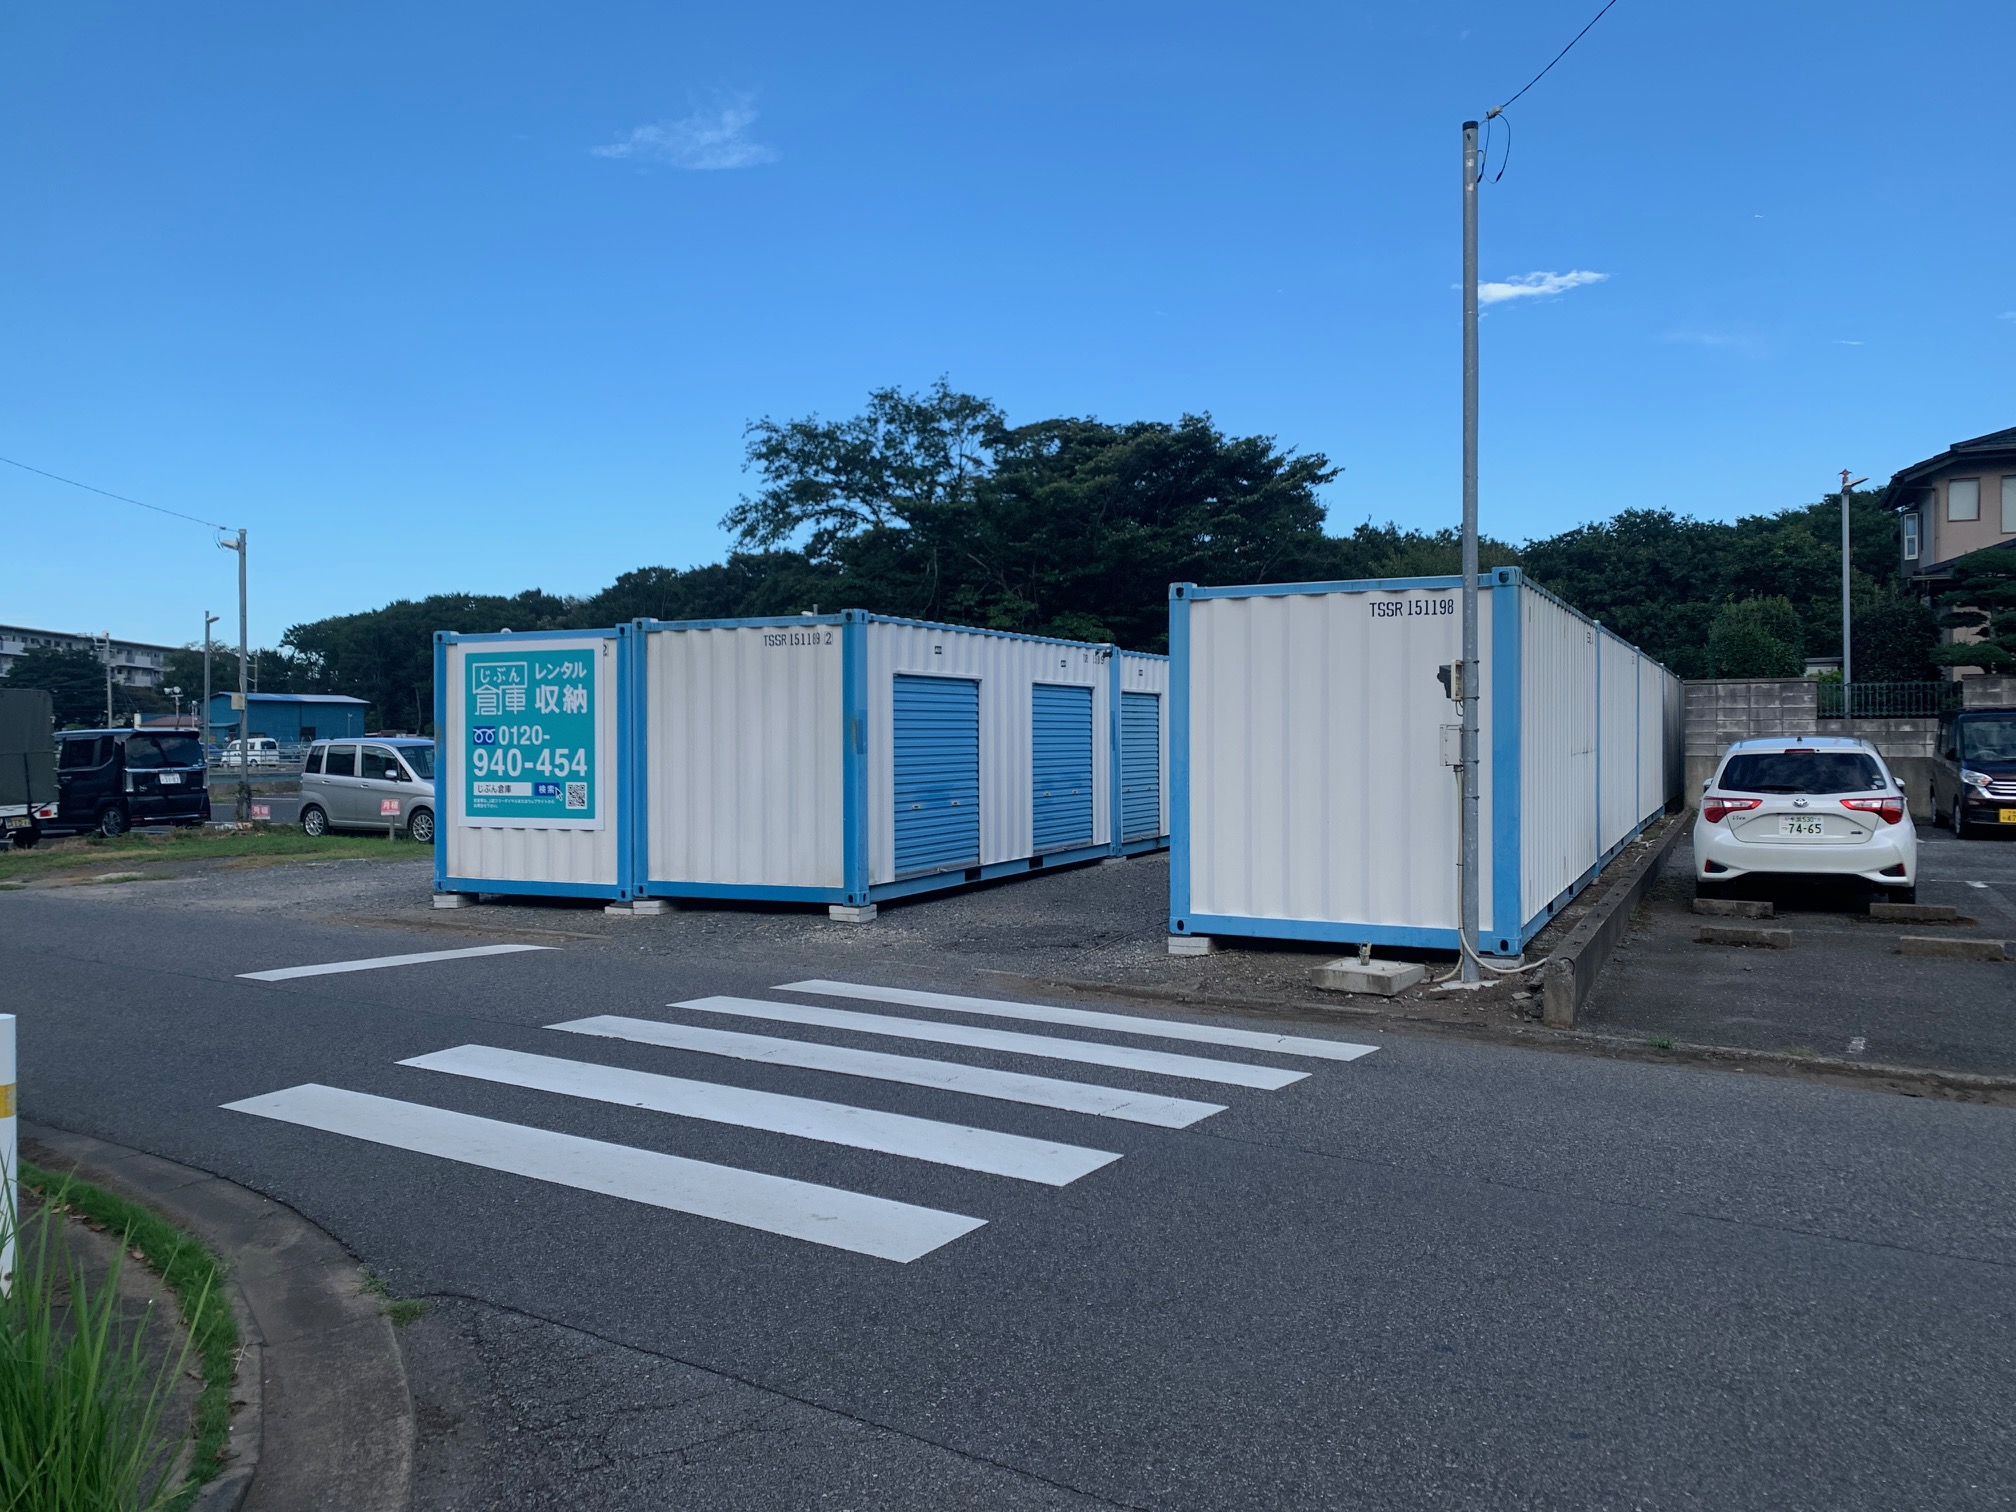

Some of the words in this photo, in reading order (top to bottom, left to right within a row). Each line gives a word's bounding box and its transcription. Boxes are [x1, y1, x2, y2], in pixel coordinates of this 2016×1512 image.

[1369, 601, 1403, 617] TSSR
[1407, 599, 1454, 616] 151198
[764, 633, 787, 647] TSSR
[480, 667, 520, 683] じぶん
[535, 661, 587, 680] レンタル
[473, 683, 526, 716] 倉庫
[535, 683, 588, 715] 収納
[472, 748, 588, 777] 940-454
[477, 784, 512, 794] じぶん倉庫
[1788, 823, 1822, 834] 74-65
